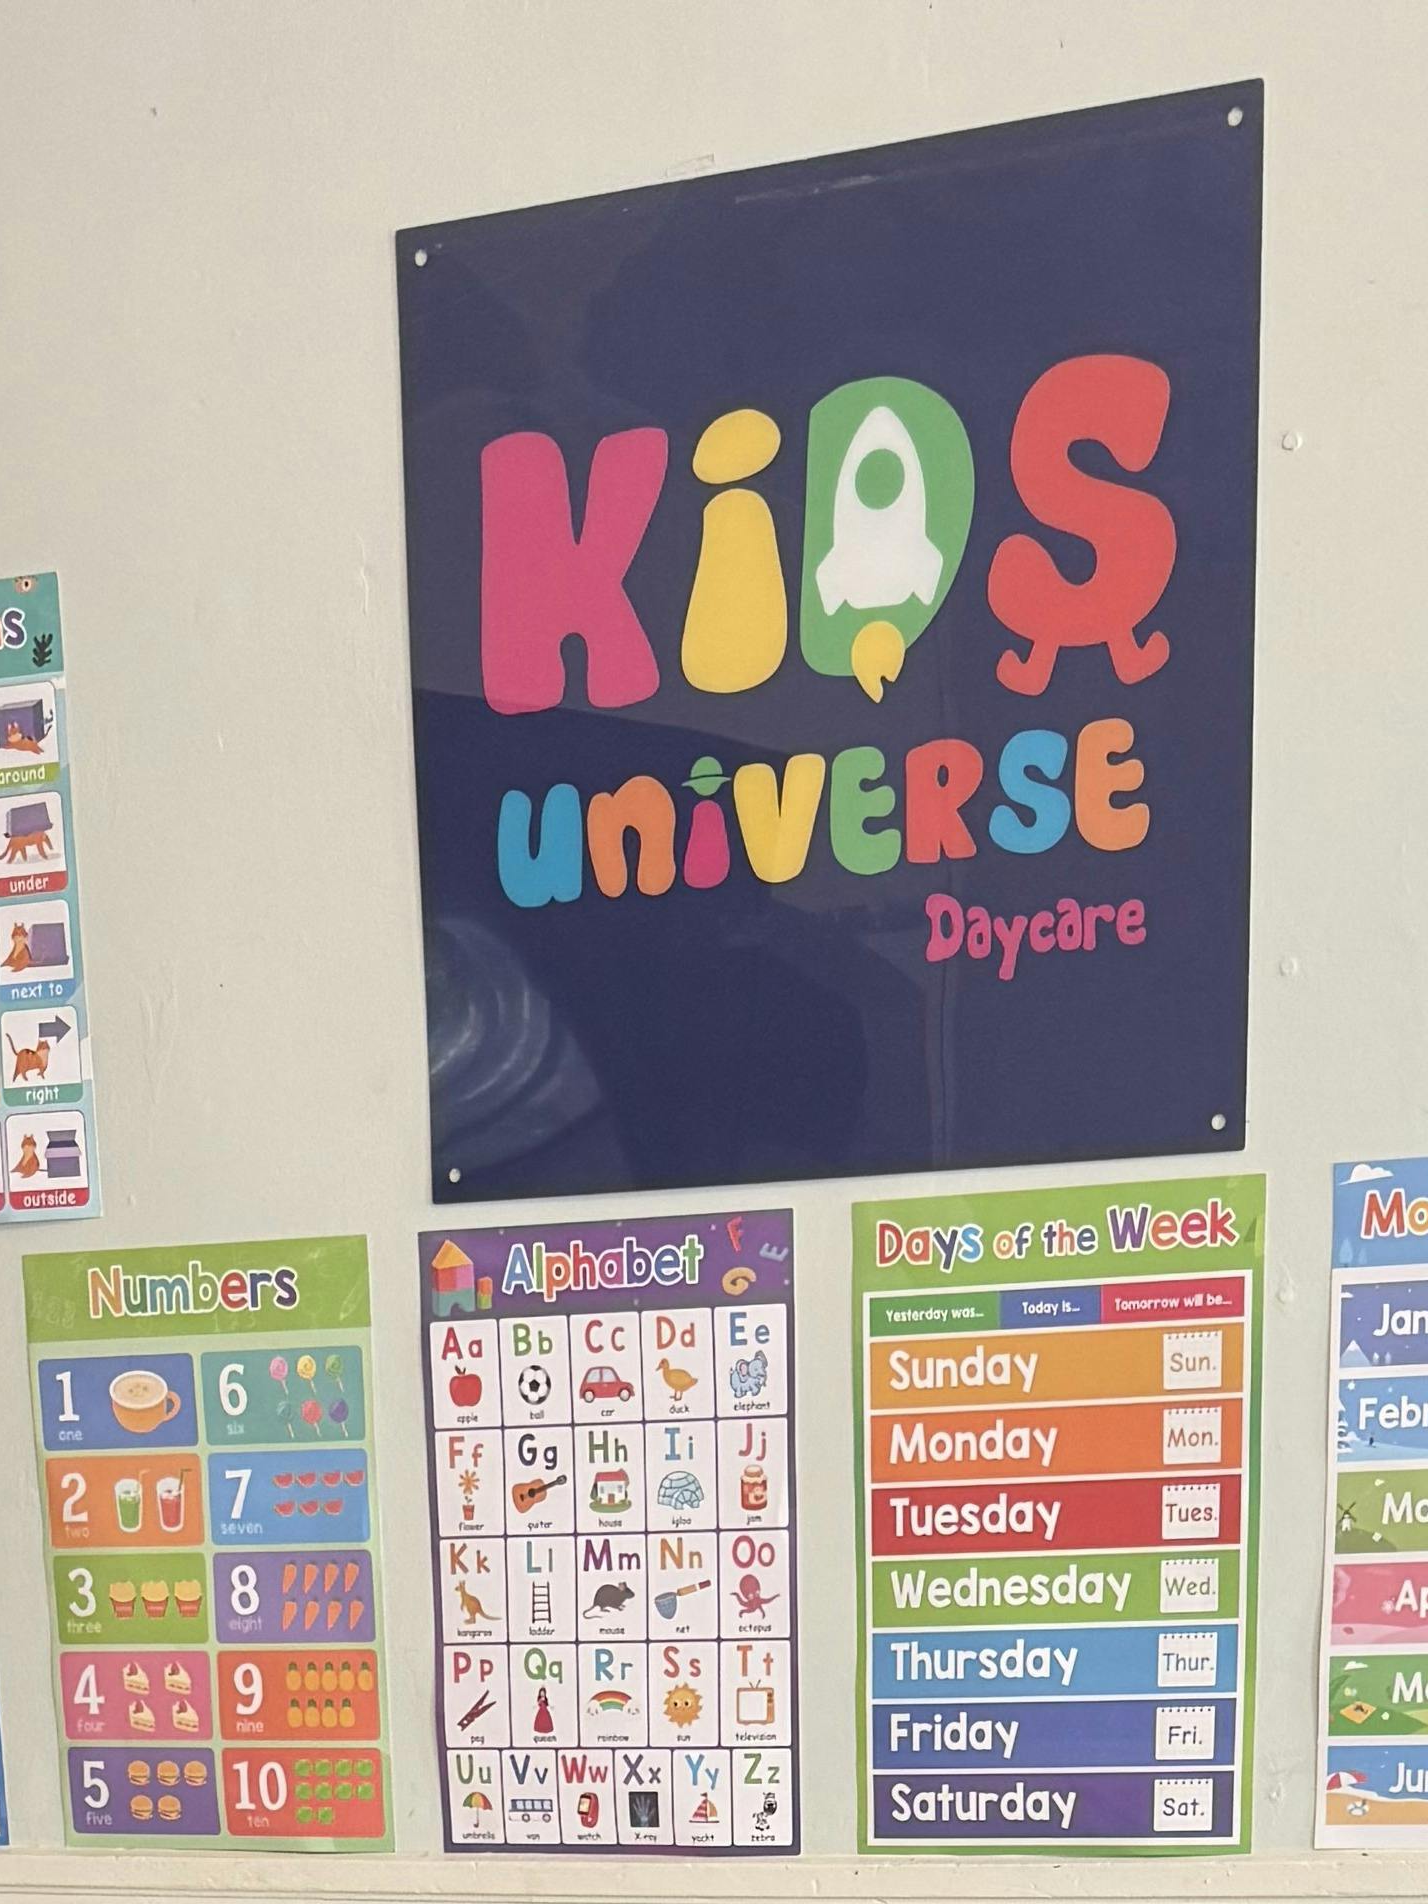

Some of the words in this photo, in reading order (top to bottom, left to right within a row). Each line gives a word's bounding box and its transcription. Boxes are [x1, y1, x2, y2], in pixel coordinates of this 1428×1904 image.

[9, 877, 49, 894] under
[925, 892, 1147, 981] Daycare
[26, 1087, 59, 1104] right
[23, 1192, 76, 1208] outside
[876, 1219, 983, 1273] Days
[993, 1222, 1034, 1259] of
[1042, 1220, 1098, 1257] the
[1107, 1197, 1237, 1253] Week
[502, 1234, 704, 1302] Alphabet
[87, 1260, 298, 1319] Numbers
[886, 1309, 948, 1323] Yesterday
[1022, 1301, 1059, 1316] Today
[441, 1327, 483, 1361] Aa
[513, 1323, 553, 1356] Bb
[584, 1320, 625, 1353] Cc
[656, 1316, 696, 1349] Dd
[889, 1345, 1038, 1393] Sunday
[55, 1371, 80, 1422] 1
[218, 1363, 247, 1416] 6
[59, 1429, 83, 1442] one
[889, 1419, 1058, 1467] Monday
[1167, 1428, 1219, 1447] Mon.
[61, 1472, 88, 1522] 2
[225, 1469, 252, 1519] 7
[221, 1522, 263, 1535] seven
[889, 1493, 1061, 1541] Tuesday
[583, 1538, 641, 1572] Mm
[732, 1535, 775, 1569] Oo
[68, 1567, 97, 1617] 3
[230, 1564, 260, 1615] 8
[890, 1565, 1132, 1612] Wednesday
[229, 1617, 262, 1633] eight
[523, 1647, 563, 1683] Qq
[891, 1639, 1078, 1686] Thursday
[735, 1733, 777, 1741] television
[890, 1712, 1019, 1759] Friday
[1168, 1726, 1203, 1744] Fri.
[233, 1760, 288, 1811] 10
[561, 1754, 608, 1784] Ww
[890, 1782, 1076, 1829] Saturday
